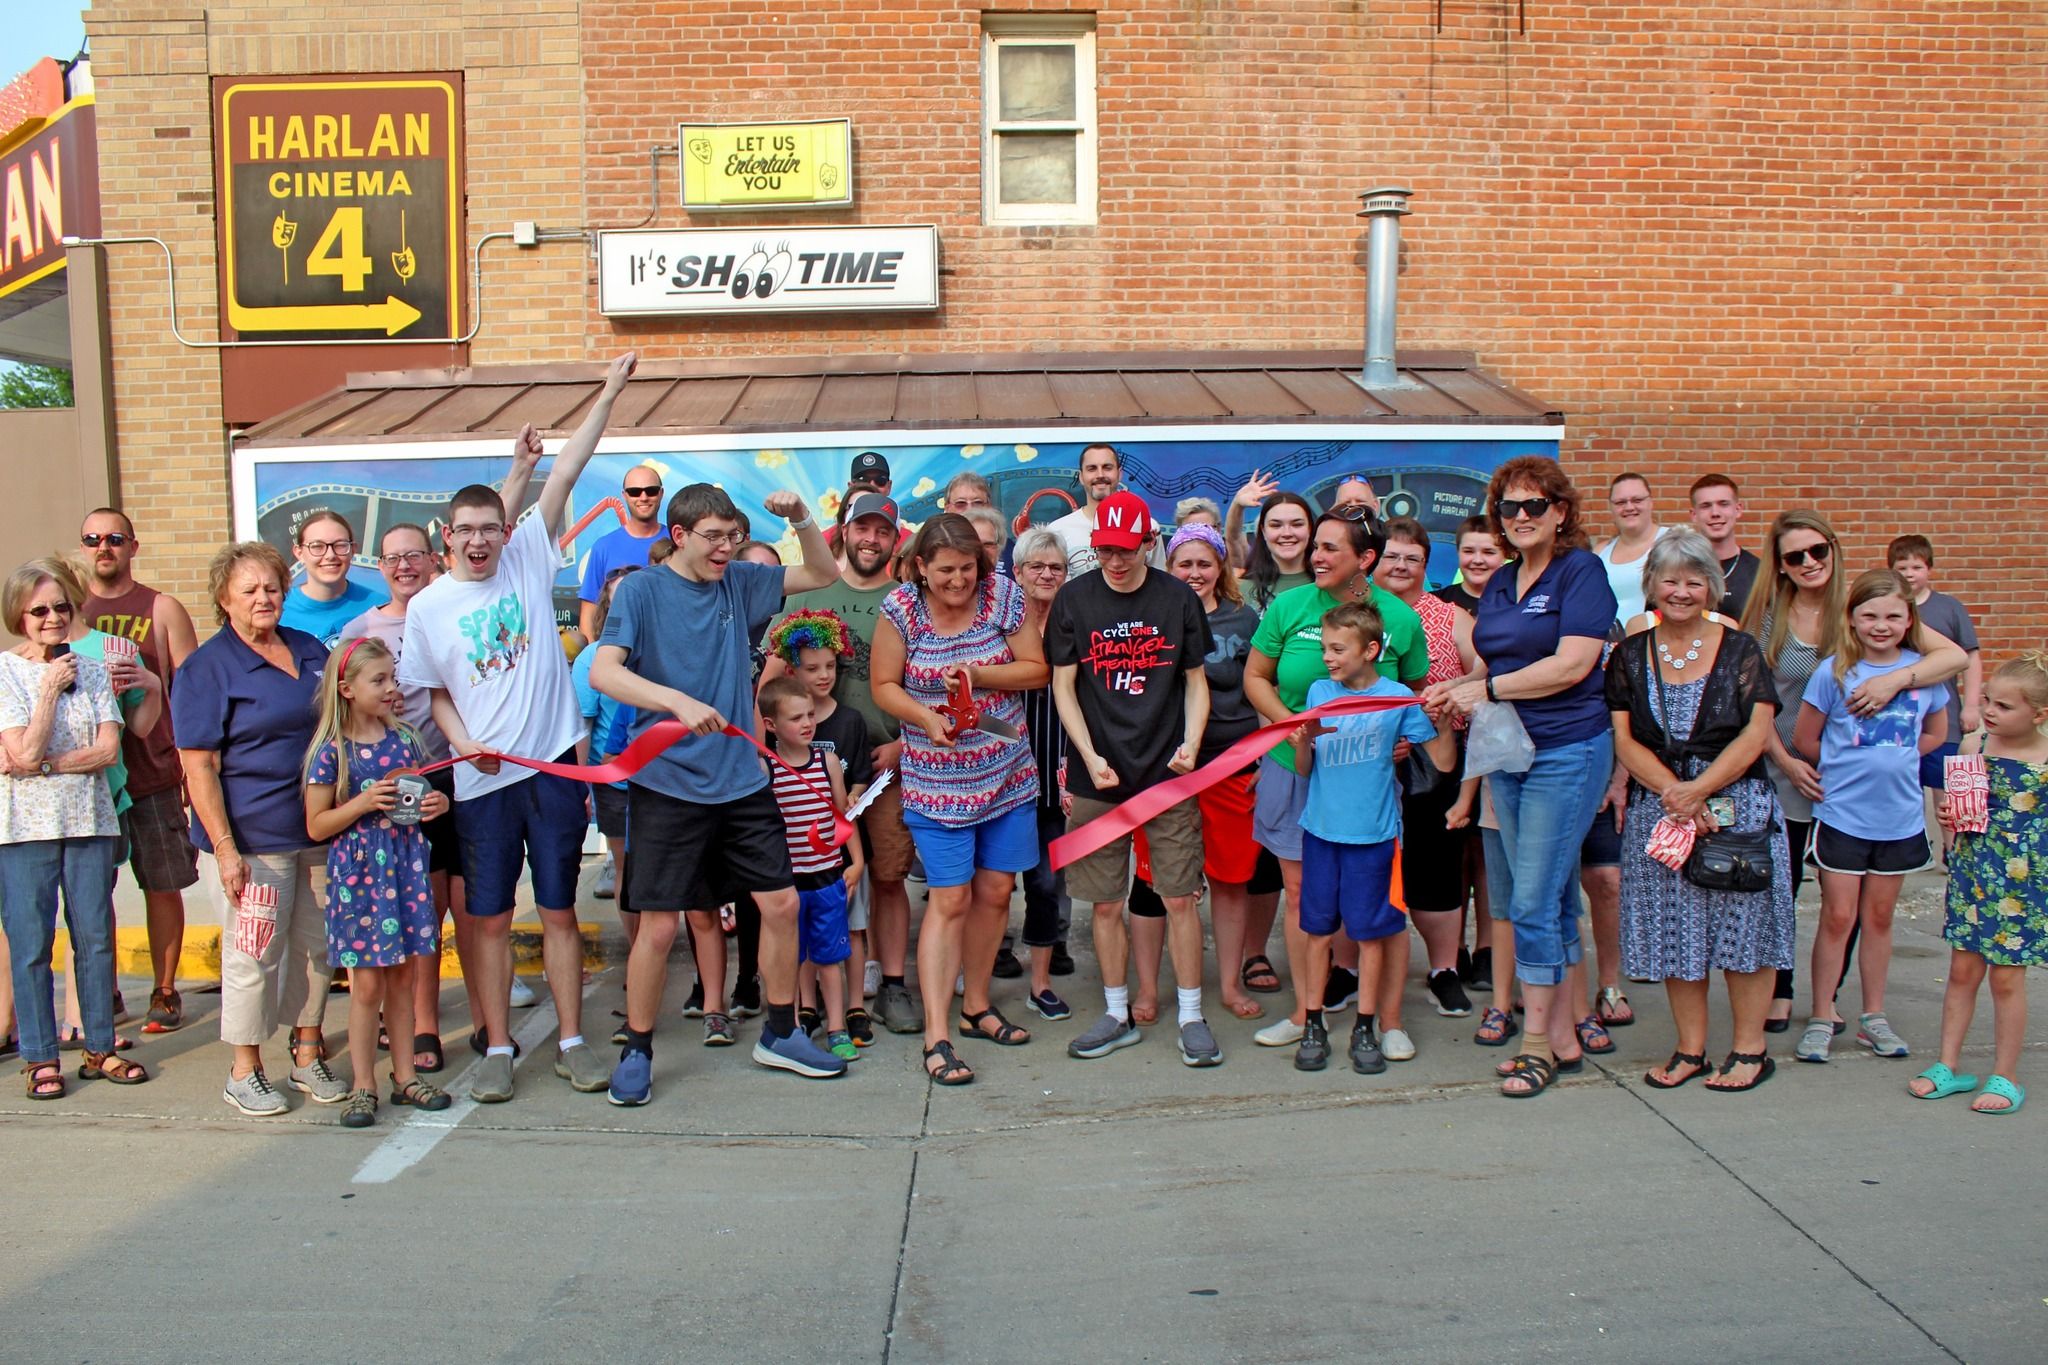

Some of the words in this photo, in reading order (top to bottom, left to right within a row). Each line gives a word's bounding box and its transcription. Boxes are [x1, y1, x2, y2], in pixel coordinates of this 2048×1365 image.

[248, 113, 431, 160] HARLAN
[736, 136, 765, 153] LET
[773, 136, 796, 152] US
[724, 151, 801, 177] Entertain
[268, 170, 413, 199] CINEMA
[743, 175, 782, 191] YOU
[0, 136, 63, 275] AN
[306, 207, 373, 293] 4
[629, 248, 667, 286] It's
[1434, 492, 1463, 504] PICTURE
[292, 512, 302, 522] BE
[1107, 506, 1122, 528] N
[1433, 504, 1440, 513] IN
[1441, 505, 1469, 517] HARLAN
[1103, 626, 1159, 638] CYCLONES
[1297, 630, 1322, 641] Welln
[1323, 733, 1377, 768] NIKE
[1950, 780, 1969, 788] CORN
